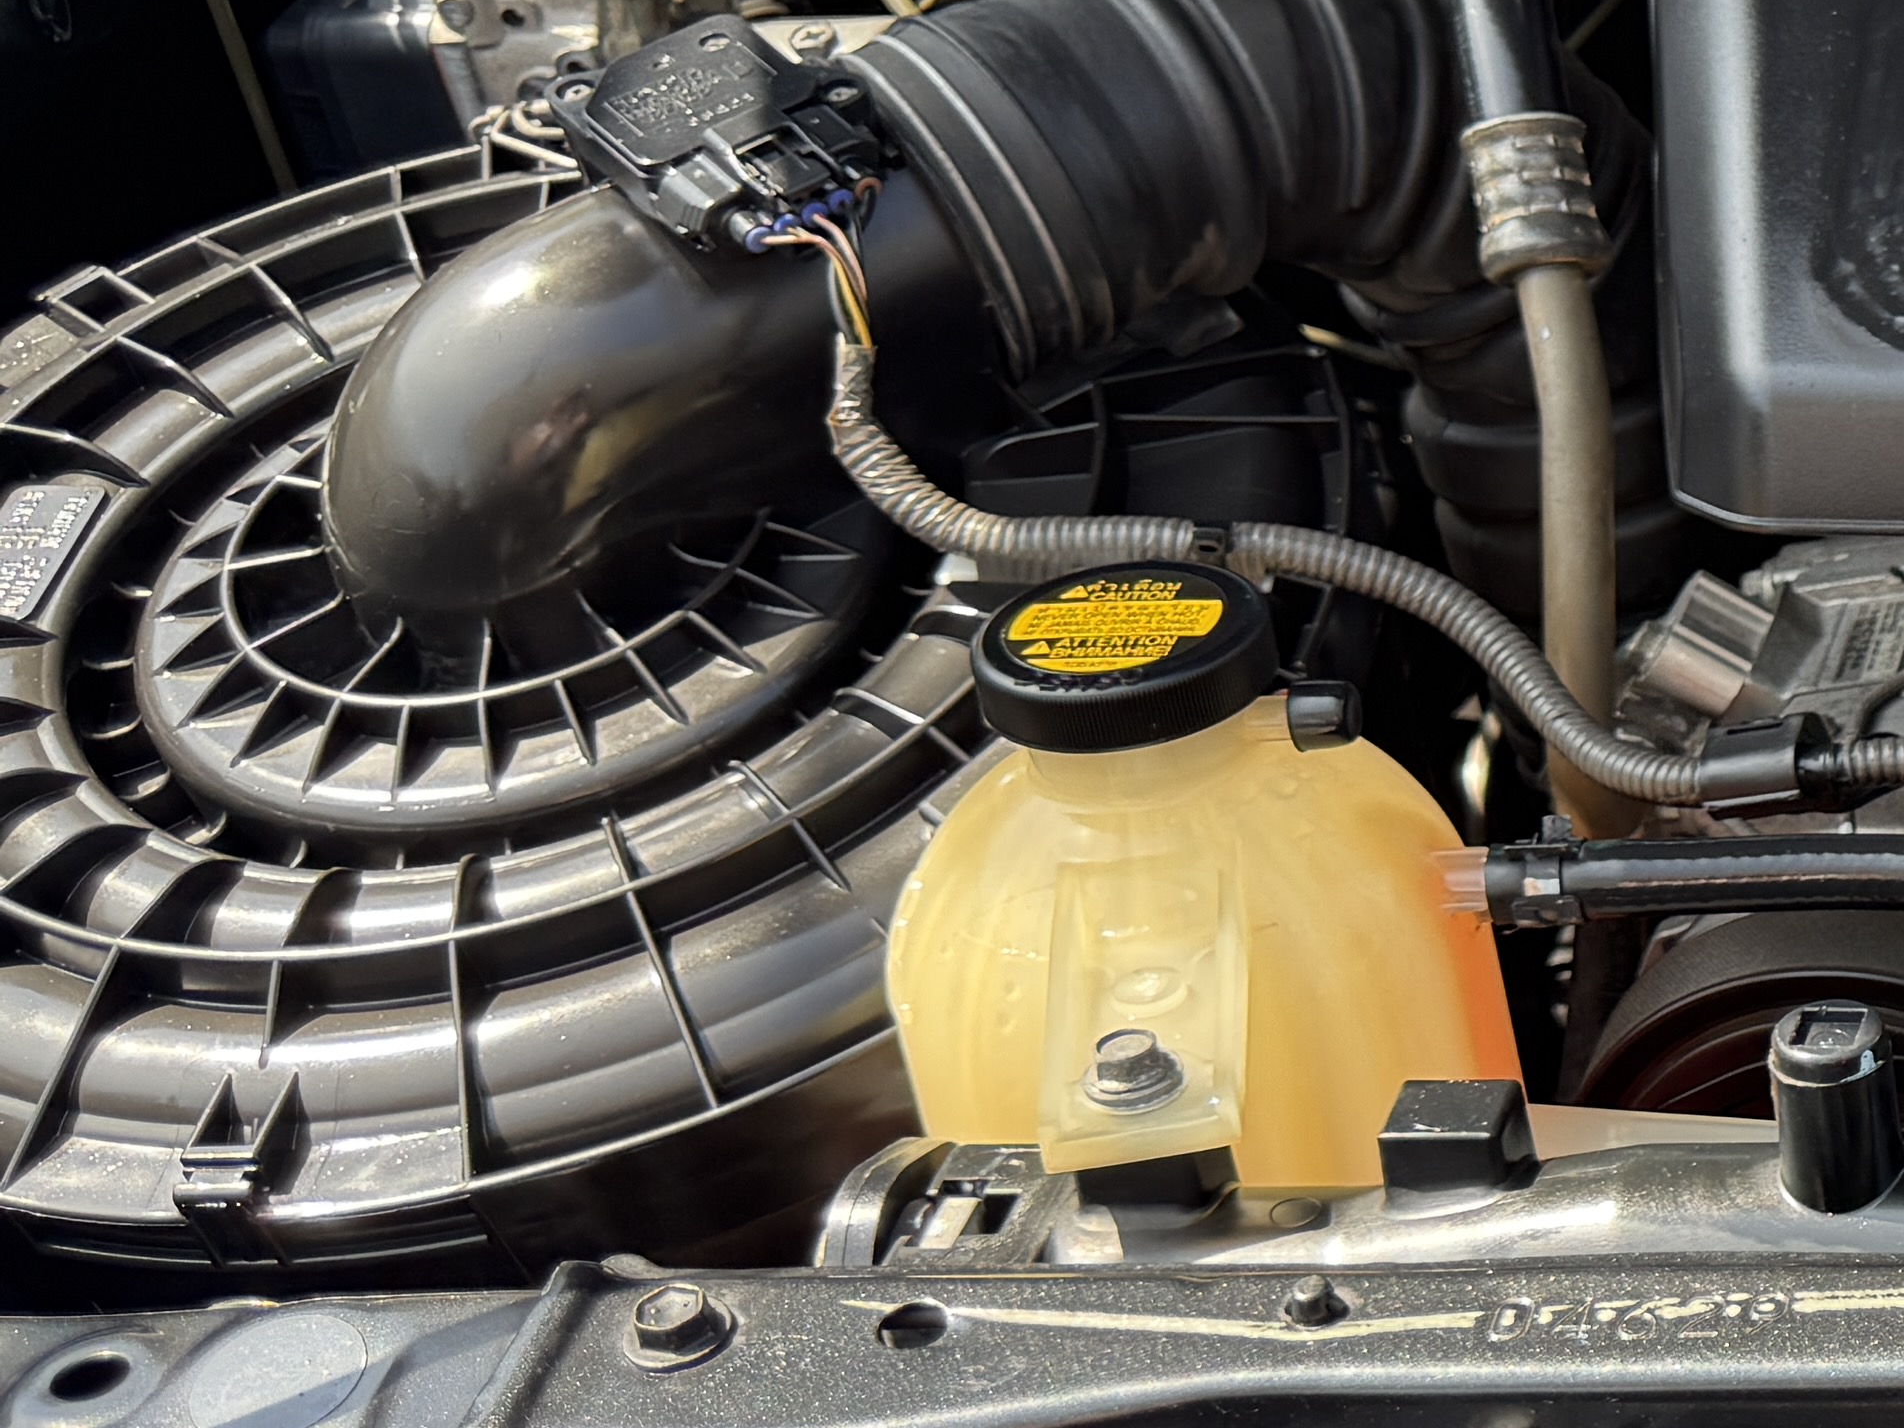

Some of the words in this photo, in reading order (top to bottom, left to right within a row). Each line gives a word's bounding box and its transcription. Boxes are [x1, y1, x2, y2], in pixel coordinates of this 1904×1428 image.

[1089, 591, 1176, 600] CAUTION
[1034, 611, 1080, 620] NEVER
[1085, 611, 1122, 619] OPEN
[1126, 610, 1167, 618] WHEN
[1054, 636, 1179, 647] ATTENTION
